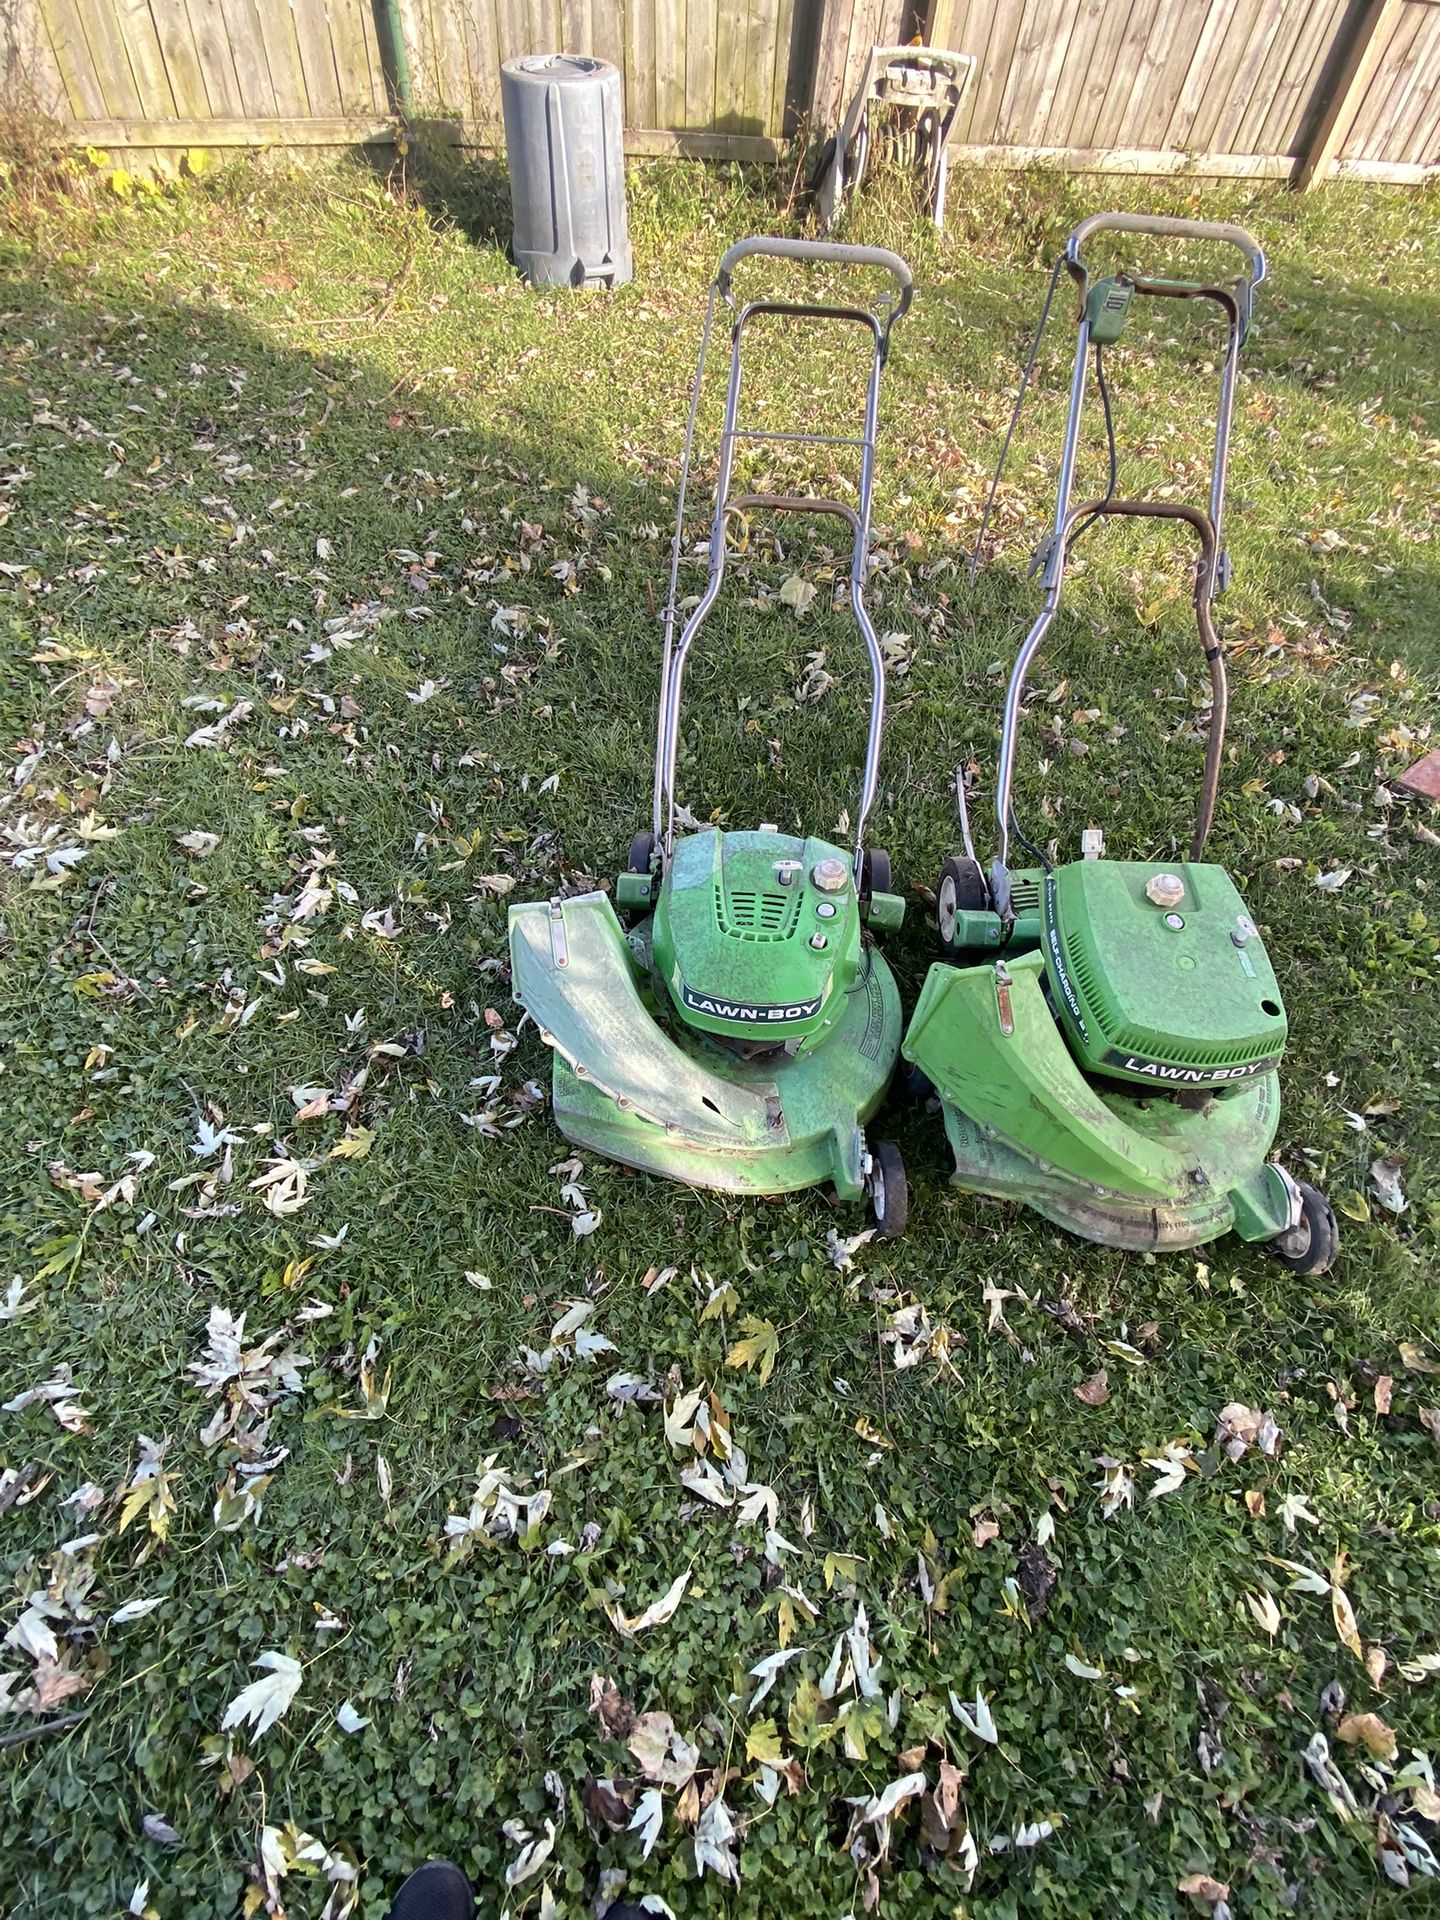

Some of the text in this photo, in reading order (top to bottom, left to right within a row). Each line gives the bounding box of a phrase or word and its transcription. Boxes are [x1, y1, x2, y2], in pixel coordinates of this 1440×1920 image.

[1050, 929, 1080, 1016] SELF-CHARGING
[688, 993, 819, 1020] LAWN-BOY
[1125, 1057, 1262, 1082] LAWN-BOY
